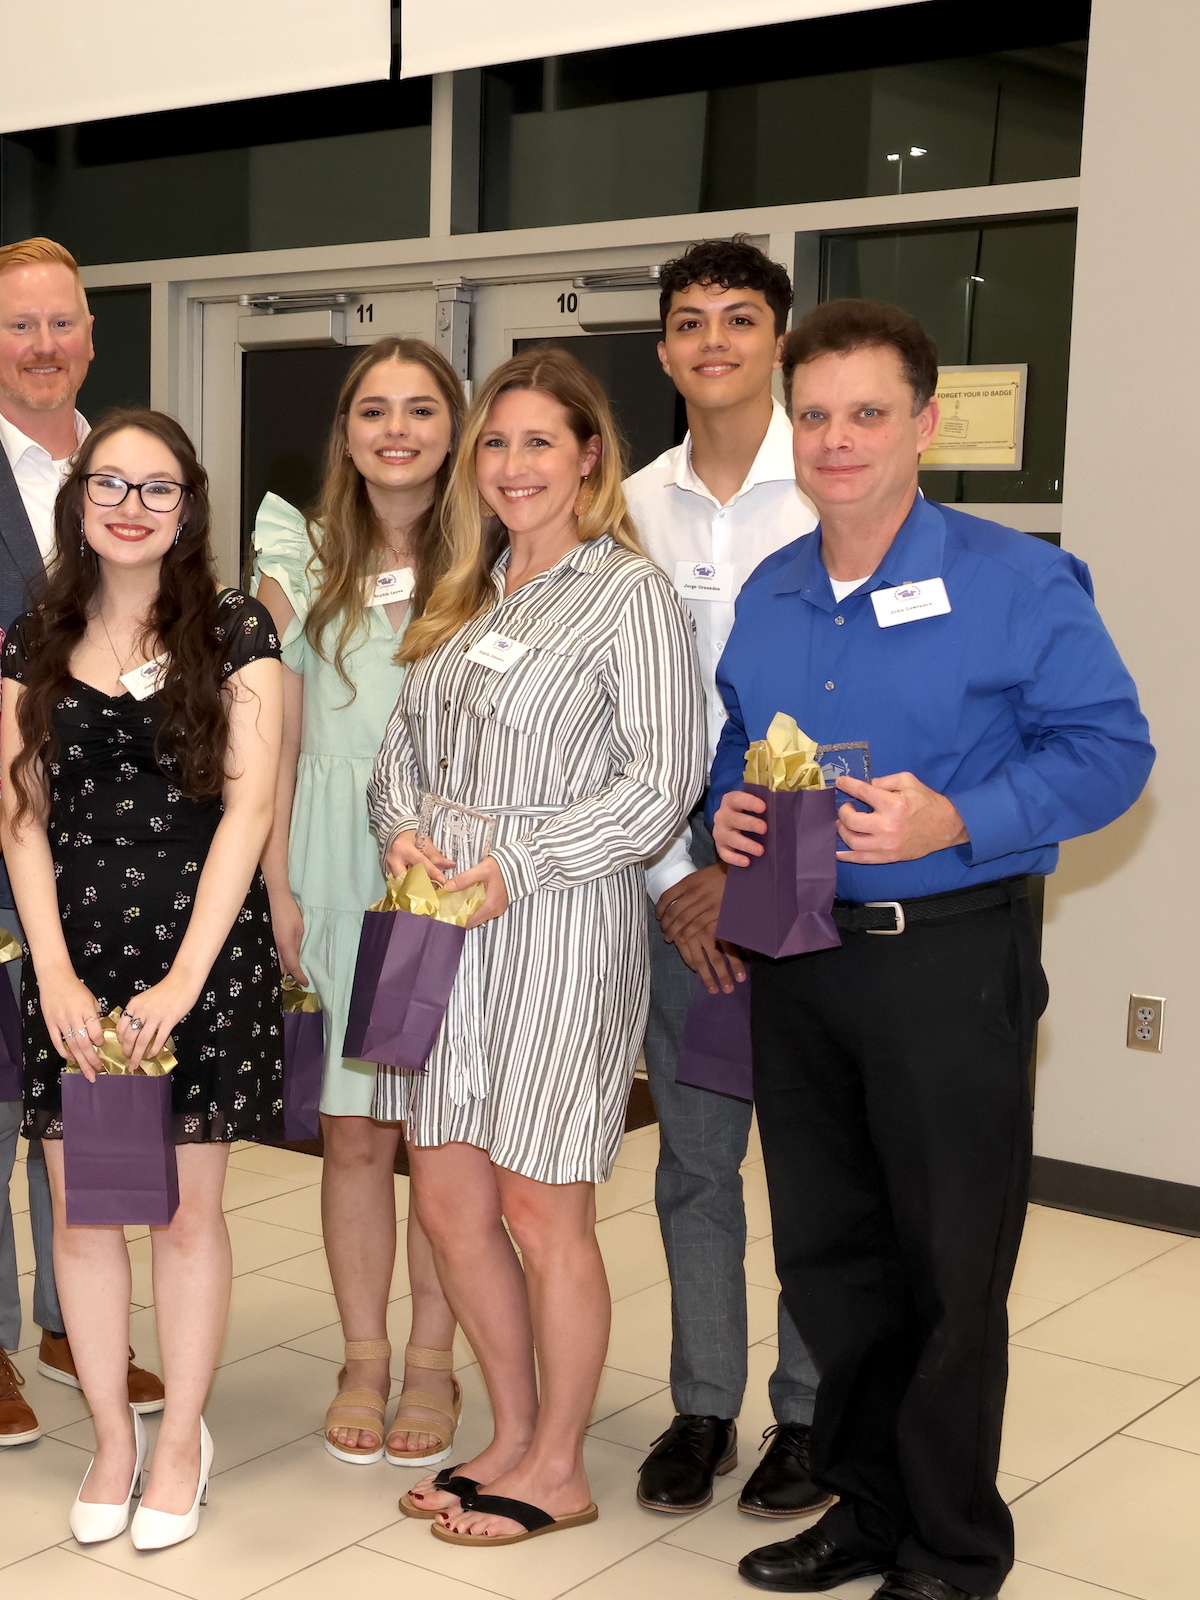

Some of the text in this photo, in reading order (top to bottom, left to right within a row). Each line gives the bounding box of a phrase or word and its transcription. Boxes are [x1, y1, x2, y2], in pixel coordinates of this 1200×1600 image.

[356, 303, 373, 323] 11
[557, 293, 577, 313] 10
[937, 391, 962, 399] FORGET
